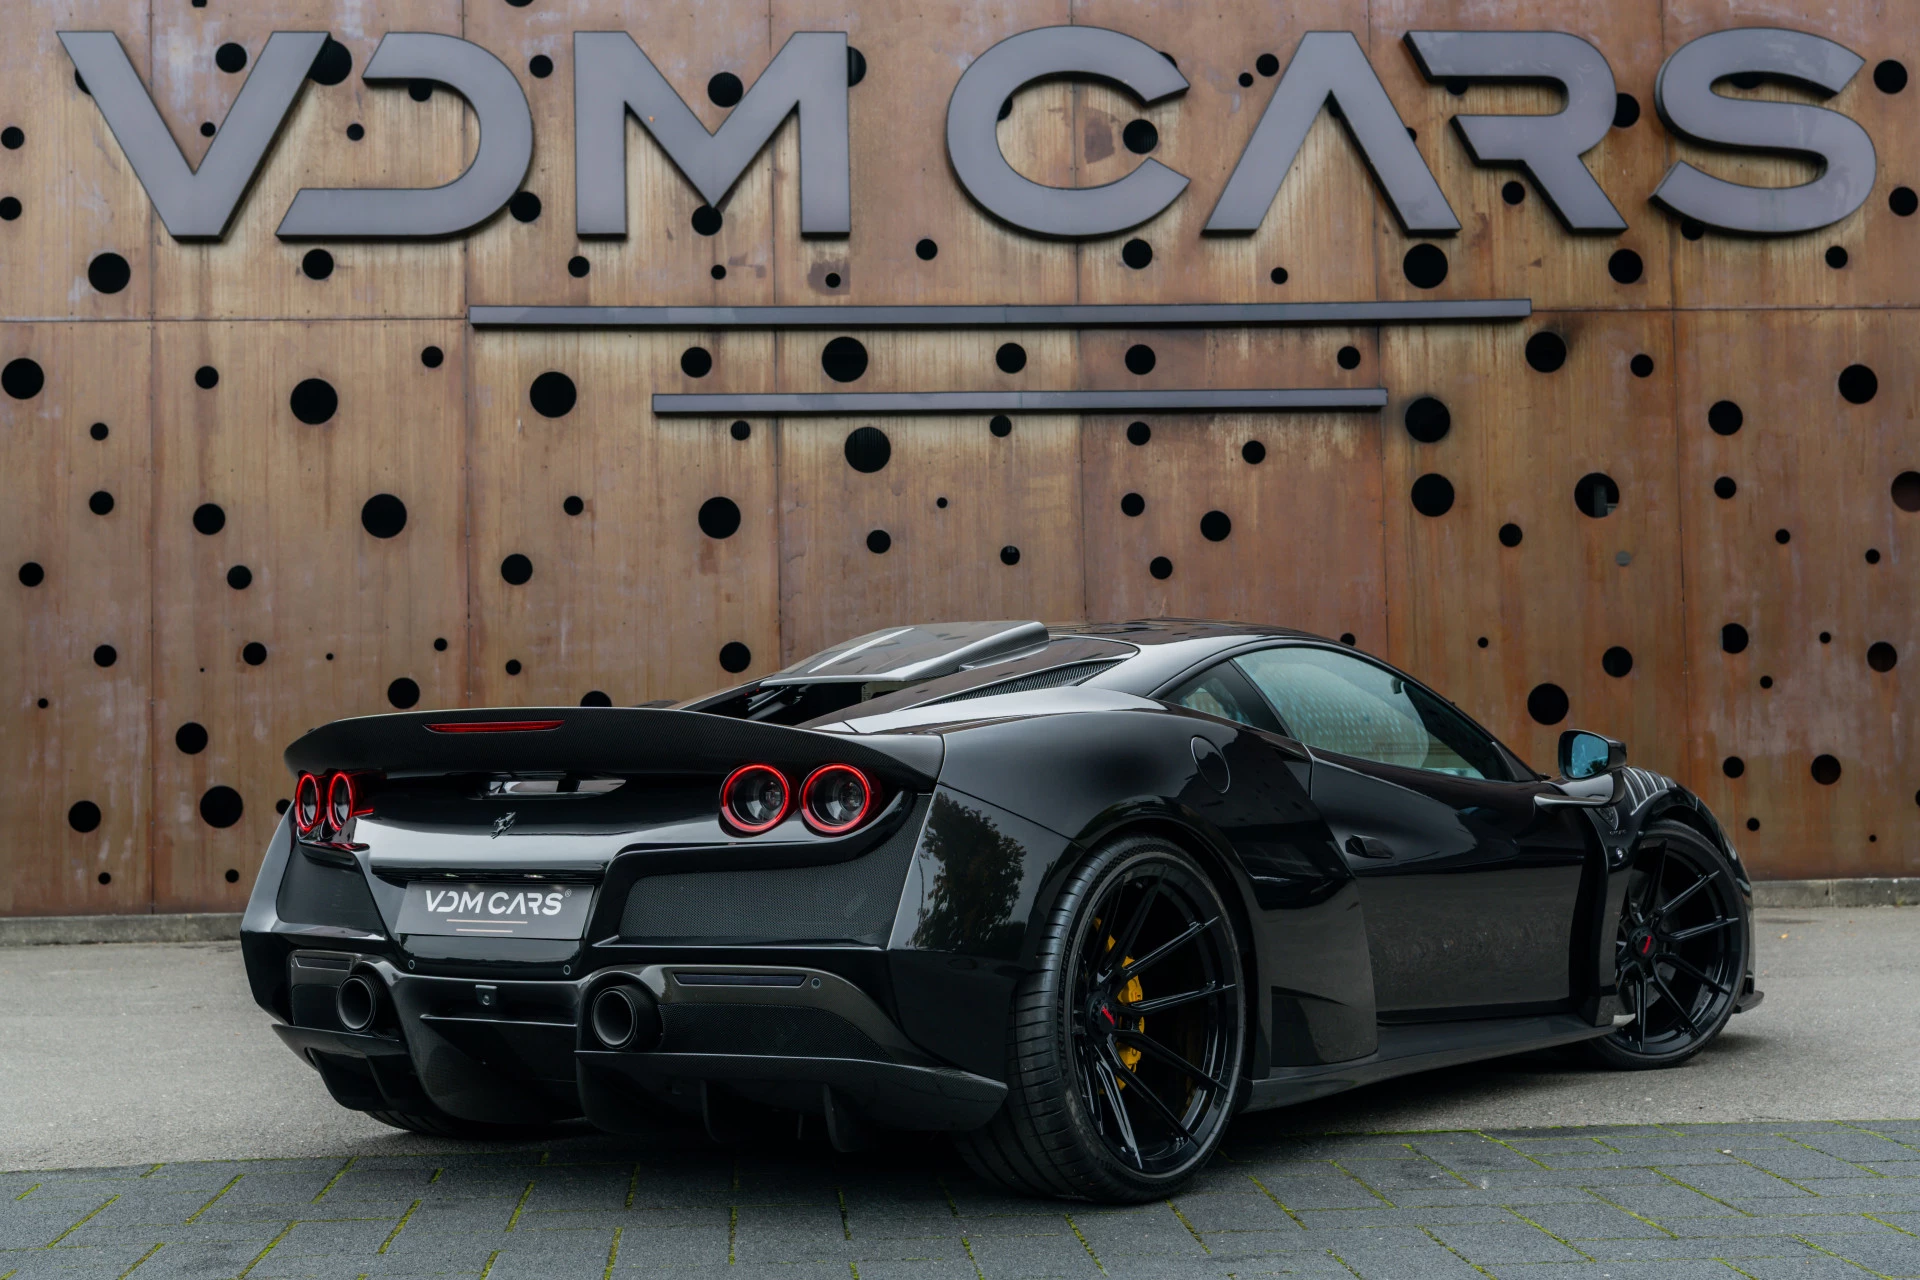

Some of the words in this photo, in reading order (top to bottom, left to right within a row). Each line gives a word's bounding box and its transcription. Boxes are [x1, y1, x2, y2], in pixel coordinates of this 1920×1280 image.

[56, 31, 851, 242] VDM
[946, 25, 1877, 238] CARS
[425, 889, 485, 914] VDM
[1057, 999, 1068, 1070] MICHELIN
